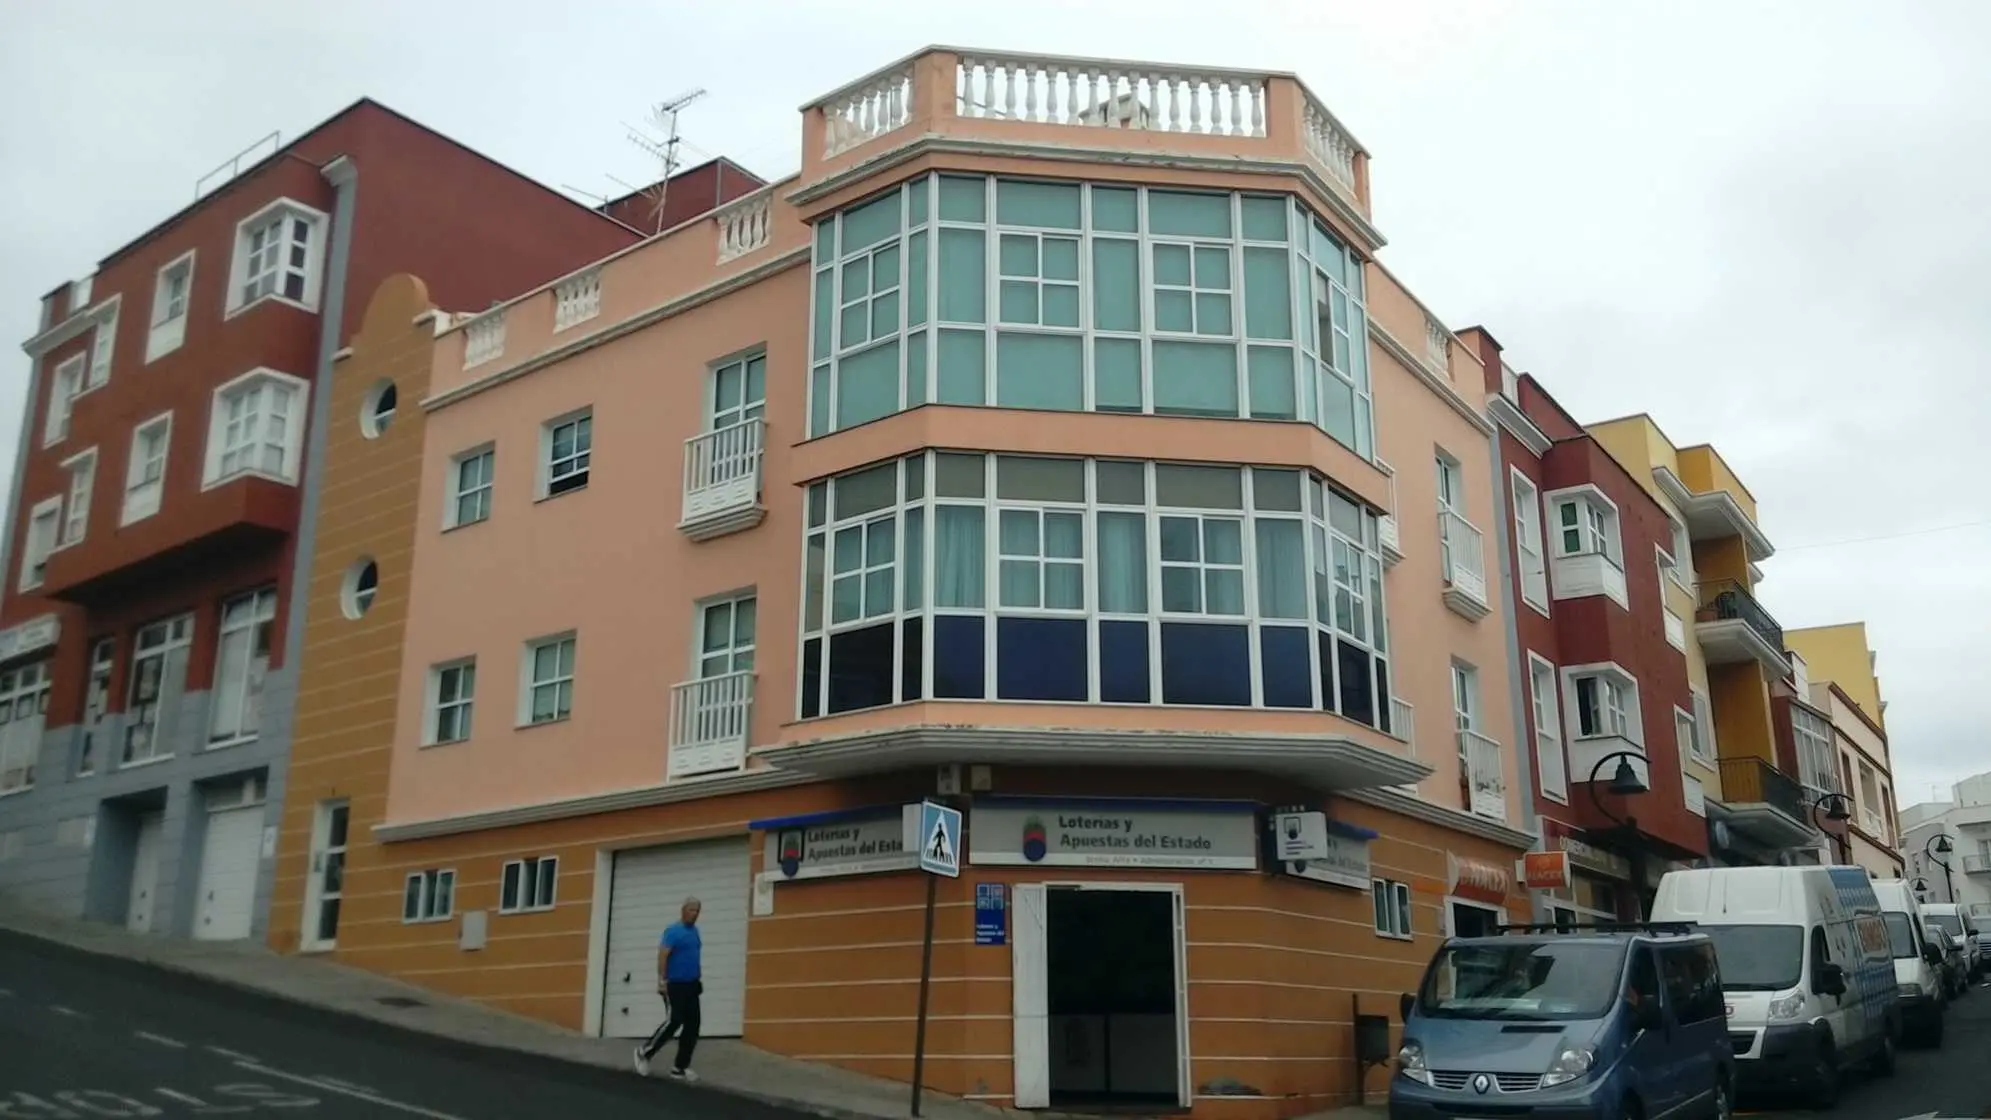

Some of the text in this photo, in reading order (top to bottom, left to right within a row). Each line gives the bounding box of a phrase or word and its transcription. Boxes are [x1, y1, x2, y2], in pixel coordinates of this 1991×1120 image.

[1124, 818, 1133, 833] y
[853, 828, 861, 842] y
[1060, 833, 1212, 850] Apuestas del Estado
[808, 839, 903, 862] Apuestas del Esta
